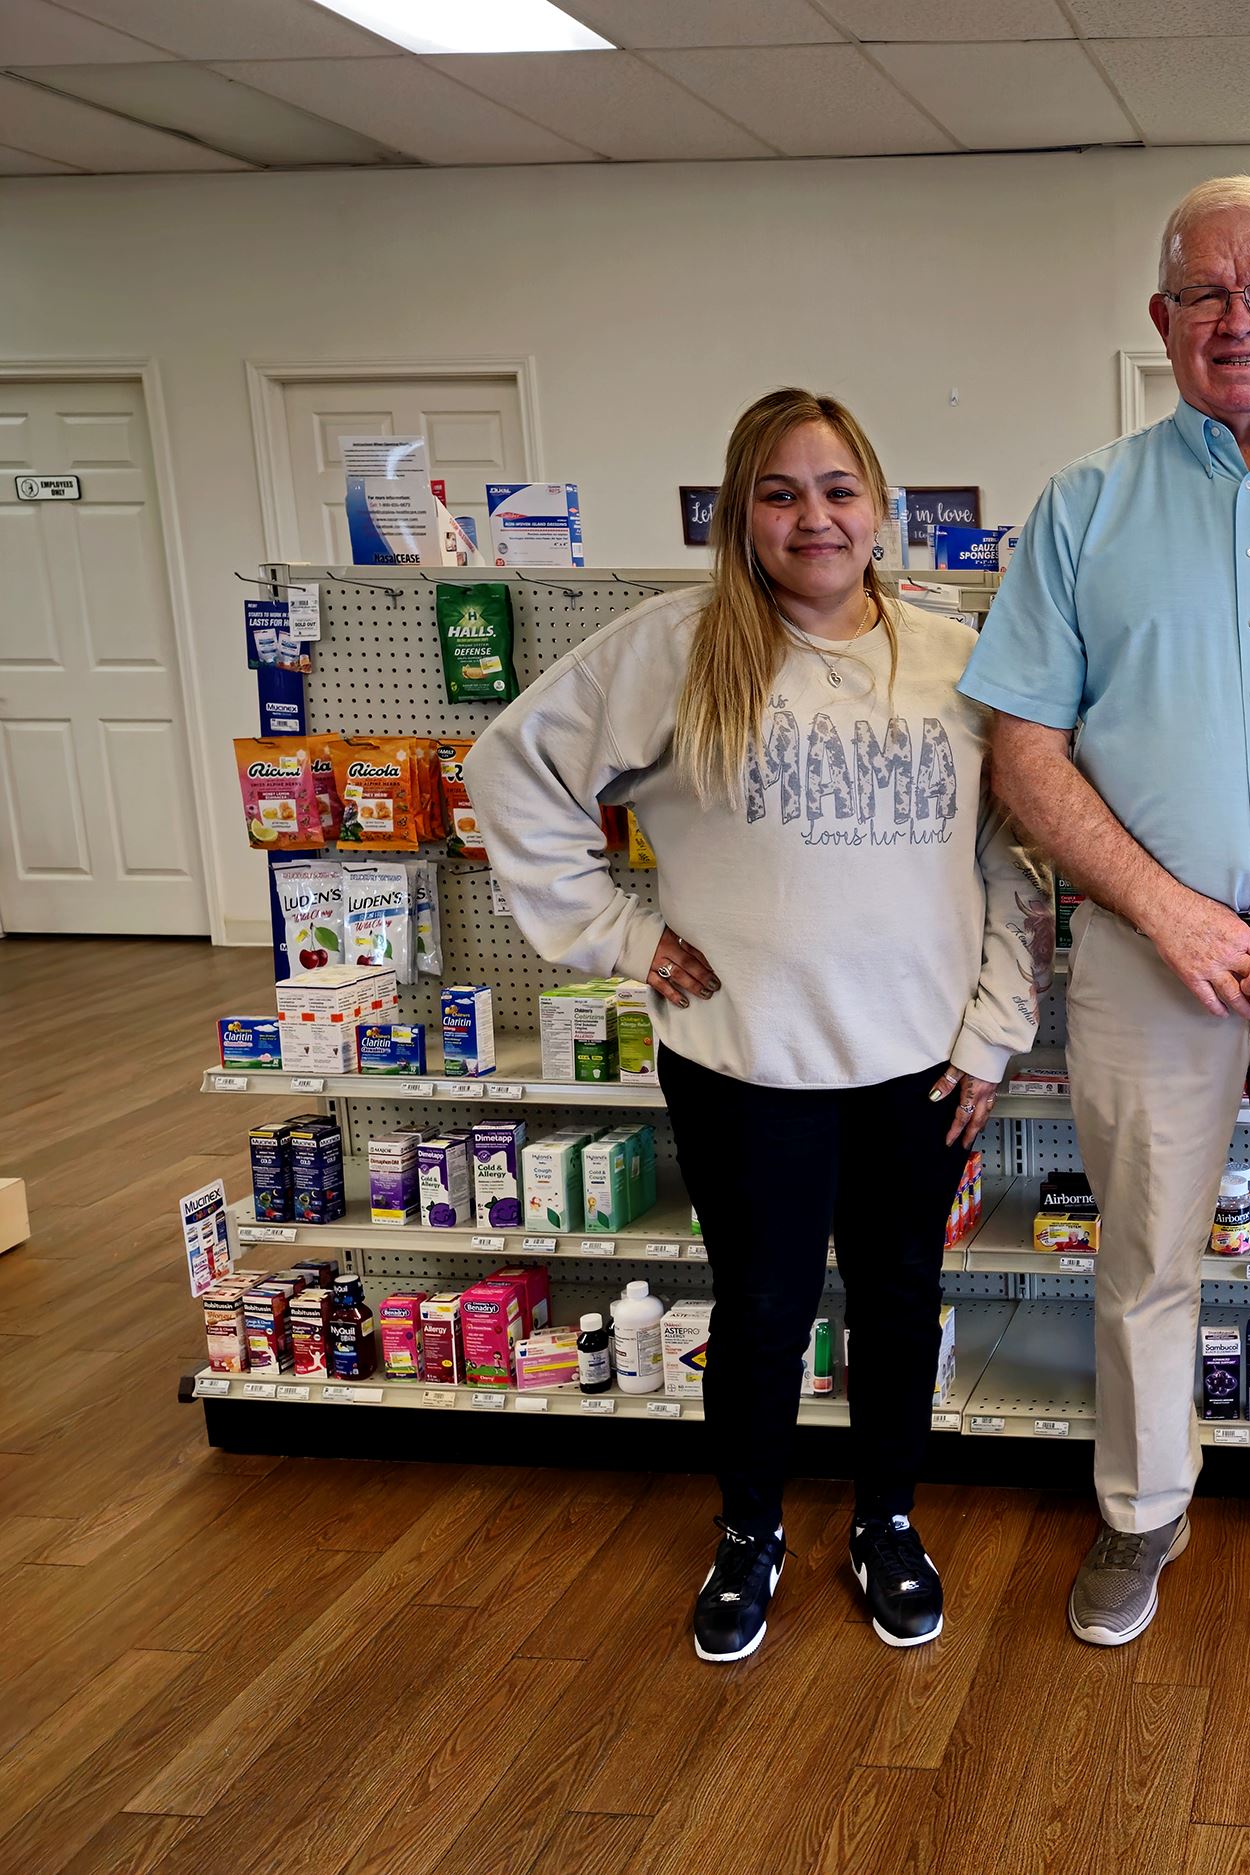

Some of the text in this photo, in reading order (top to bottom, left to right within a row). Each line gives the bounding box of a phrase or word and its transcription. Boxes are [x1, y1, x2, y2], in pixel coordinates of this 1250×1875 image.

[41, 481, 73, 489] EMPLOYEES
[51, 488, 65, 497] ONLY
[916, 502, 975, 523] in love.
[374, 553, 420, 564] NasalCEASE
[959, 551, 999, 560] SPONGES
[454, 647, 492, 656] DEFENSE
[267, 703, 298, 712] Mucinex
[349, 763, 400, 777] Ricola
[801, 816, 953, 846] Loves her herd
[284, 888, 342, 912] LUDEN'S
[349, 891, 402, 912] LUDEN'S
[443, 1016, 472, 1027] Claritin
[223, 1032, 253, 1041] Claritin
[362, 1037, 391, 1048] Claritin
[475, 1133, 512, 1143] Dimetapp
[418, 1150, 444, 1160] Dimetapp
[420, 1175, 434, 1183] Cold
[478, 1170, 507, 1179] Allergy
[534, 1172, 552, 1180] Syrup
[421, 1181, 441, 1189] Allergy
[185, 1187, 222, 1215] Mucinex
[1044, 1193, 1096, 1206] Airborne
[244, 1304, 272, 1312] Robitussin
[467, 1303, 497, 1312] Benadryl
[291, 1308, 321, 1317] Robitussin
[383, 1309, 409, 1317] Benadryl
[331, 1325, 356, 1337] NyQuil
[424, 1325, 447, 1334] Allergy
[664, 1327, 701, 1335] ASTEPRO
[1205, 1343, 1239, 1351] Sambucol
